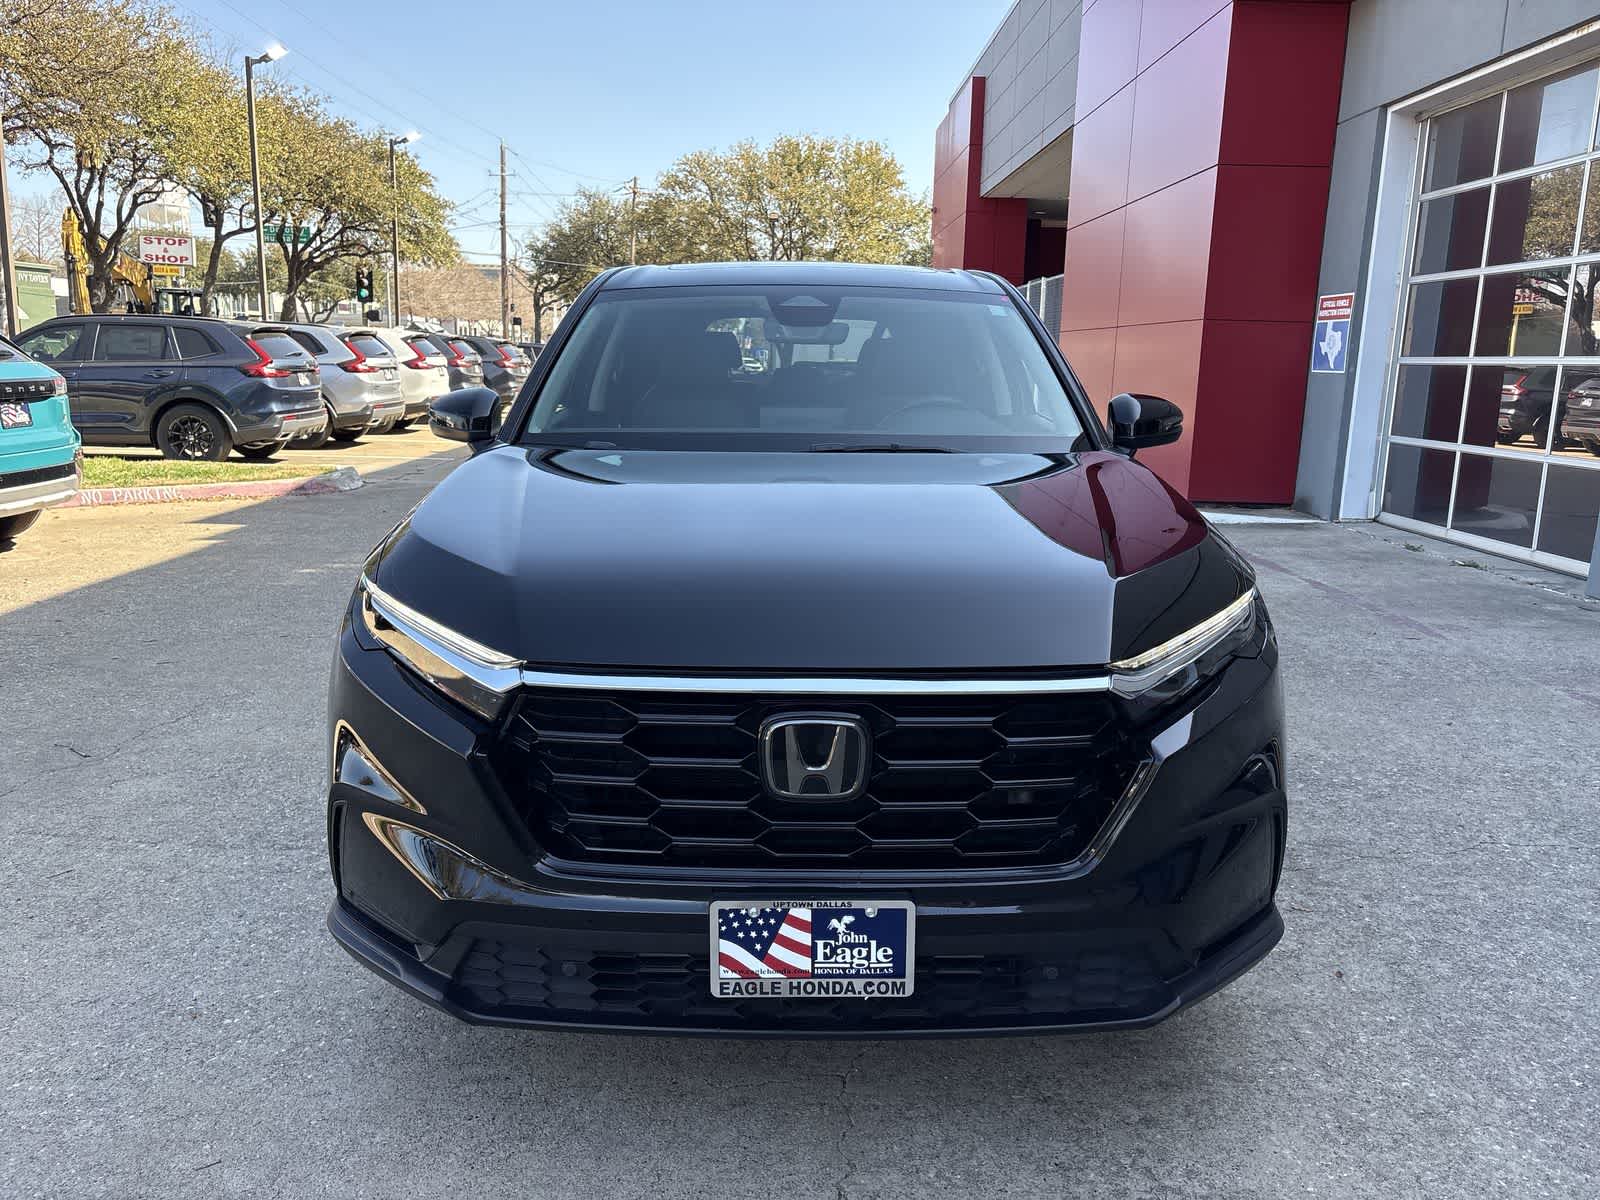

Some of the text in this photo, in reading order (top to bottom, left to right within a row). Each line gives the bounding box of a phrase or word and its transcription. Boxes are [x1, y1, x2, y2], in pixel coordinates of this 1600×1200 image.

[143, 236, 188, 246] STOP
[144, 253, 189, 263] SHOP
[81, 490, 102, 504] NO
[814, 939, 894, 969] Eagle
[722, 967, 811, 977] www.eaglehonda.com
[814, 967, 894, 975] HONDA OF DALLAS
[719, 981, 906, 996] EAGLE HONDA.COM
